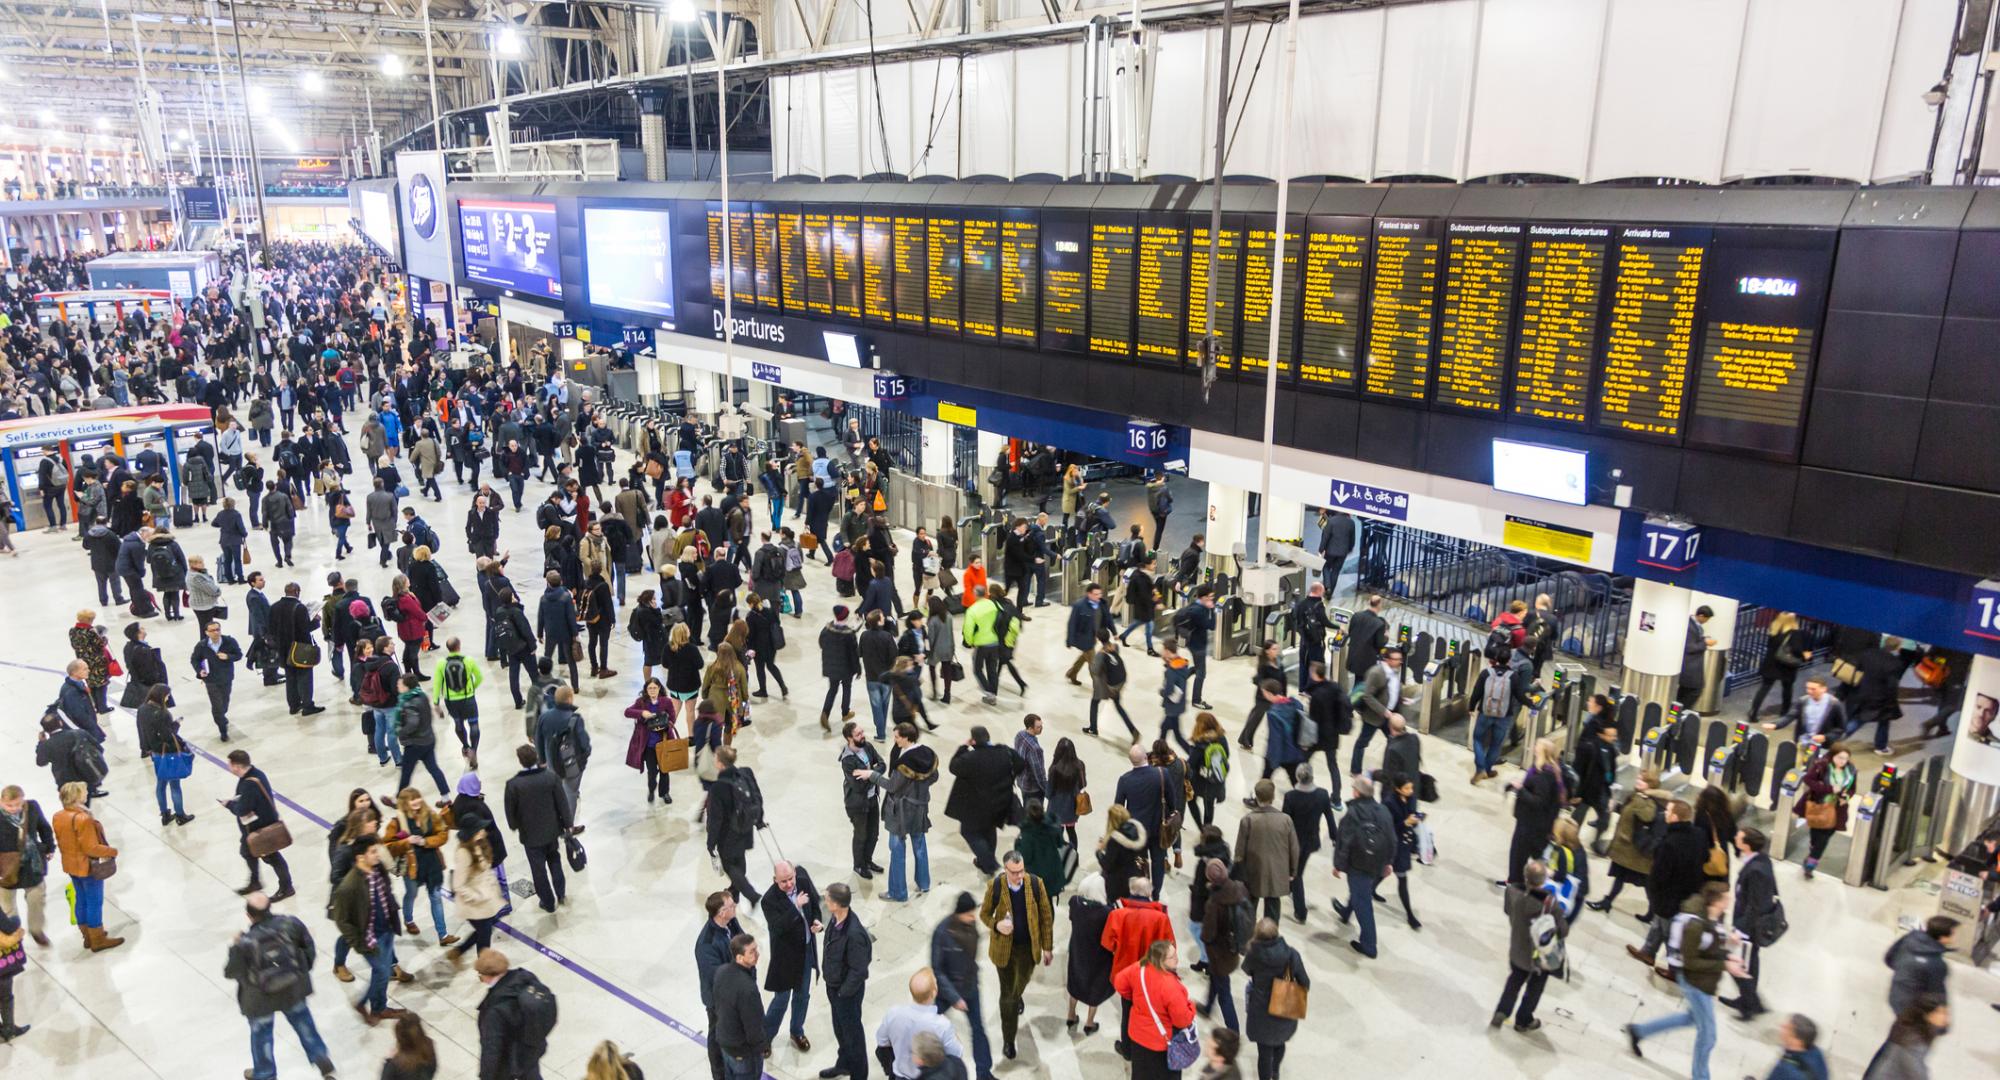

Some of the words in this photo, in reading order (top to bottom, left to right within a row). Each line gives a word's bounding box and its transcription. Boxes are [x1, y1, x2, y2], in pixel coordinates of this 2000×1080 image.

[1379, 221, 1399, 230] Fastest
[1399, 222, 1412, 230] train
[1450, 223, 1486, 234] Subsequent
[1487, 224, 1521, 234] departures
[1530, 225, 1570, 236] Subsequent
[1570, 226, 1609, 238] departures
[504, 212, 517, 253] 2
[1623, 228, 1651, 239] Arrivals
[1652, 230, 1670, 239] from
[522, 213, 537, 268] 3
[390, 264, 397, 272] 11
[469, 300, 480, 310] 12
[560, 324, 573, 337] 13
[623, 330, 630, 343] 14
[632, 329, 646, 343] 14
[875, 380, 886, 396] 15
[890, 379, 905, 396] 15
[5, 427, 74, 443] Self-service
[77, 422, 114, 434] tickets
[1129, 429, 1146, 449] 16
[1150, 429, 1167, 449] 16
[1646, 532, 1679, 560] 17
[1685, 533, 1701, 561] 17
